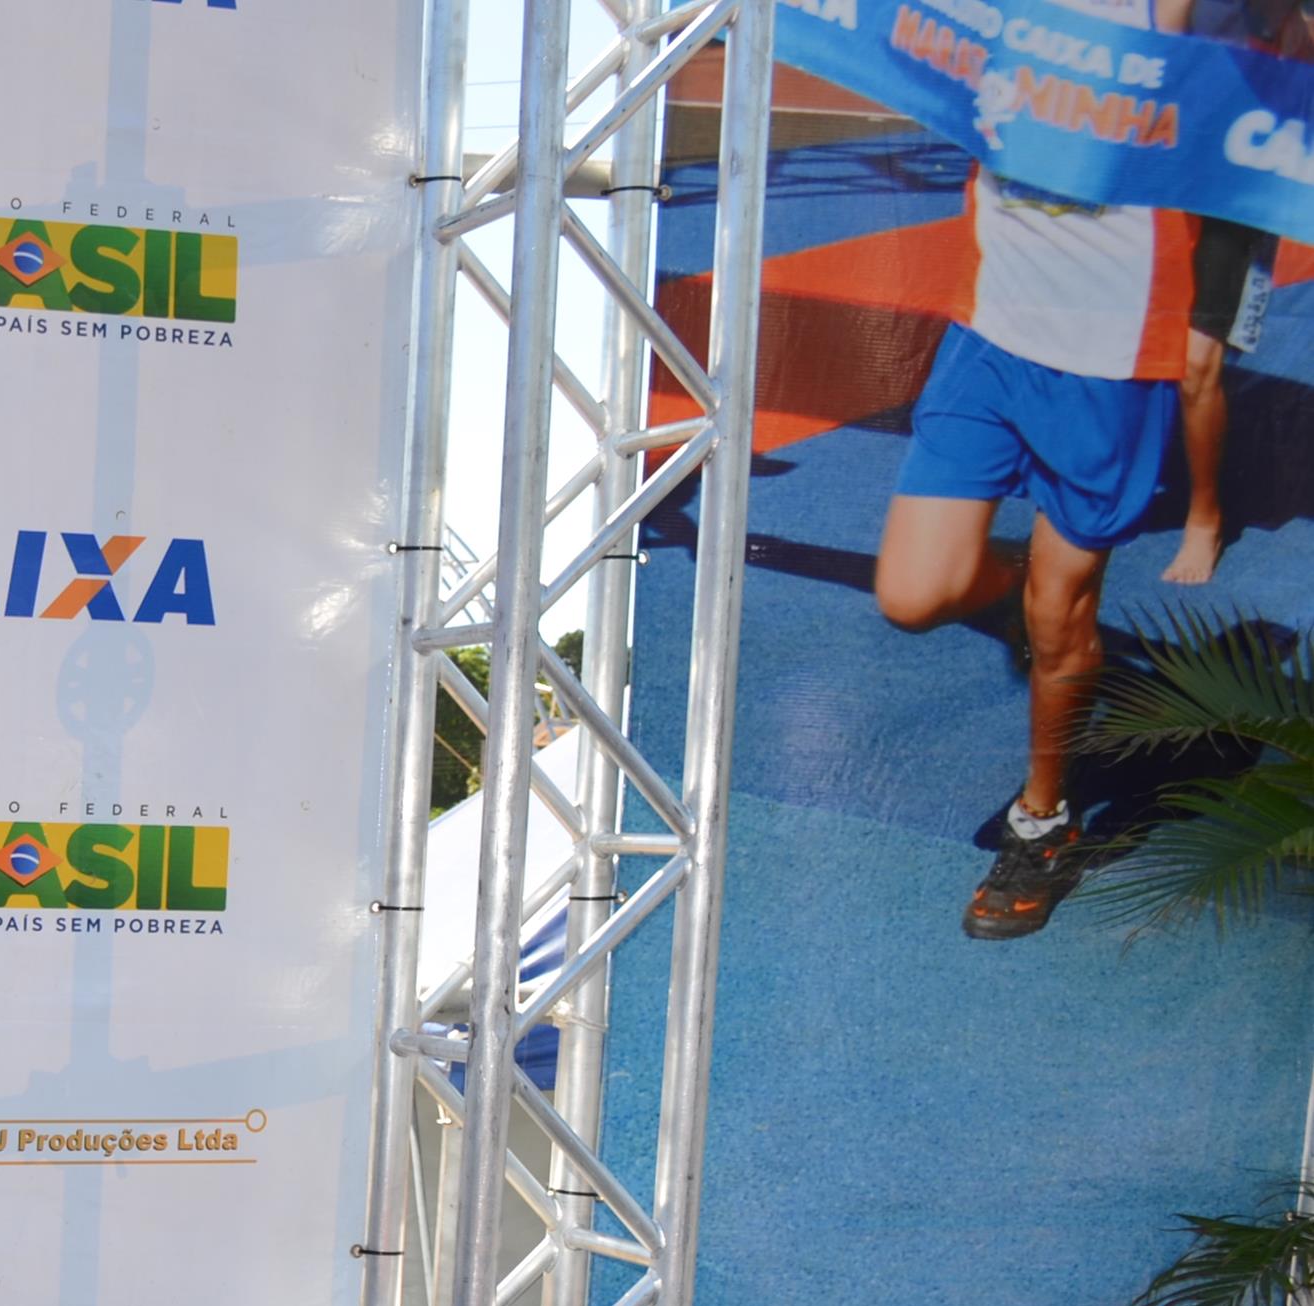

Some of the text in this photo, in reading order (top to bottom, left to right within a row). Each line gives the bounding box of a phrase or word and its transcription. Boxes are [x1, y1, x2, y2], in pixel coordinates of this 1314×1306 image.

[1118, 52, 1168, 89] DE
[62, 201, 237, 229] FEDERAL
[60, 319, 108, 340] SEM
[120, 324, 233, 348] POBREZA
[59, 801, 229, 819] FEDERAL
[55, 917, 102, 934] SEM
[113, 918, 224, 935] POBREZA
[18, 1128, 169, 1156] Produções
[177, 1128, 239, 1151] Ltda
